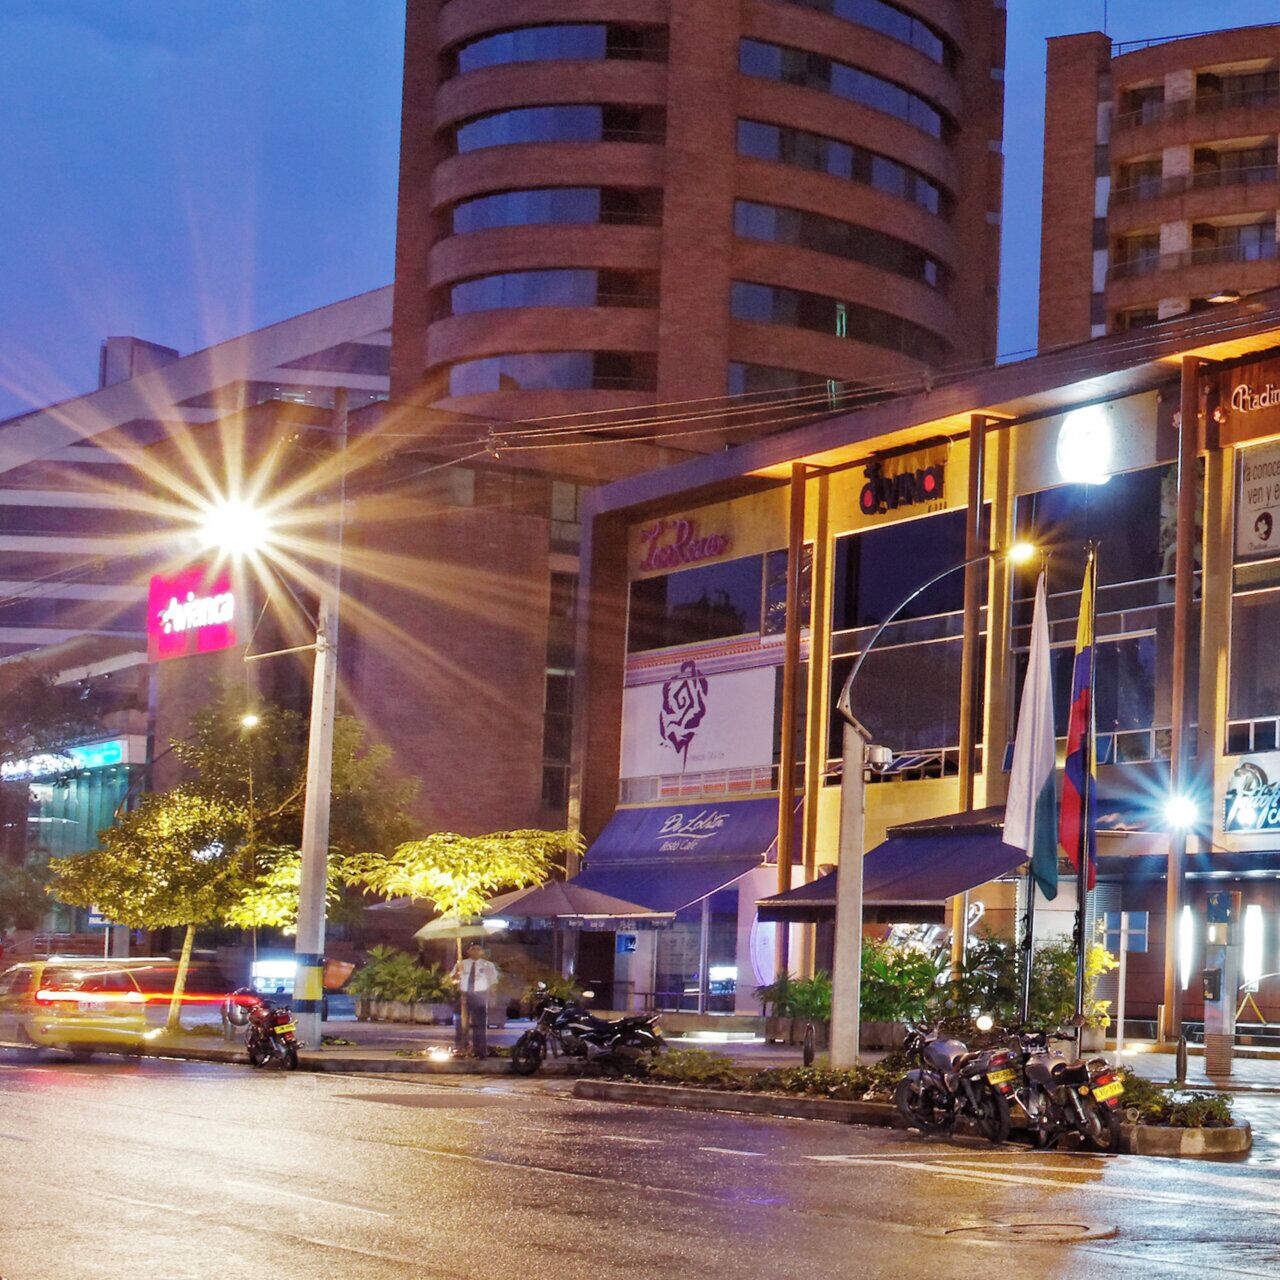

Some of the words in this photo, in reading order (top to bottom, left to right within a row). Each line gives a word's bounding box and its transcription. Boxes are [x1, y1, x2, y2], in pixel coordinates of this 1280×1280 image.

[1248, 487, 1264, 505] ven
[1266, 486, 1273, 506] y
[157, 591, 234, 634] Avianca
